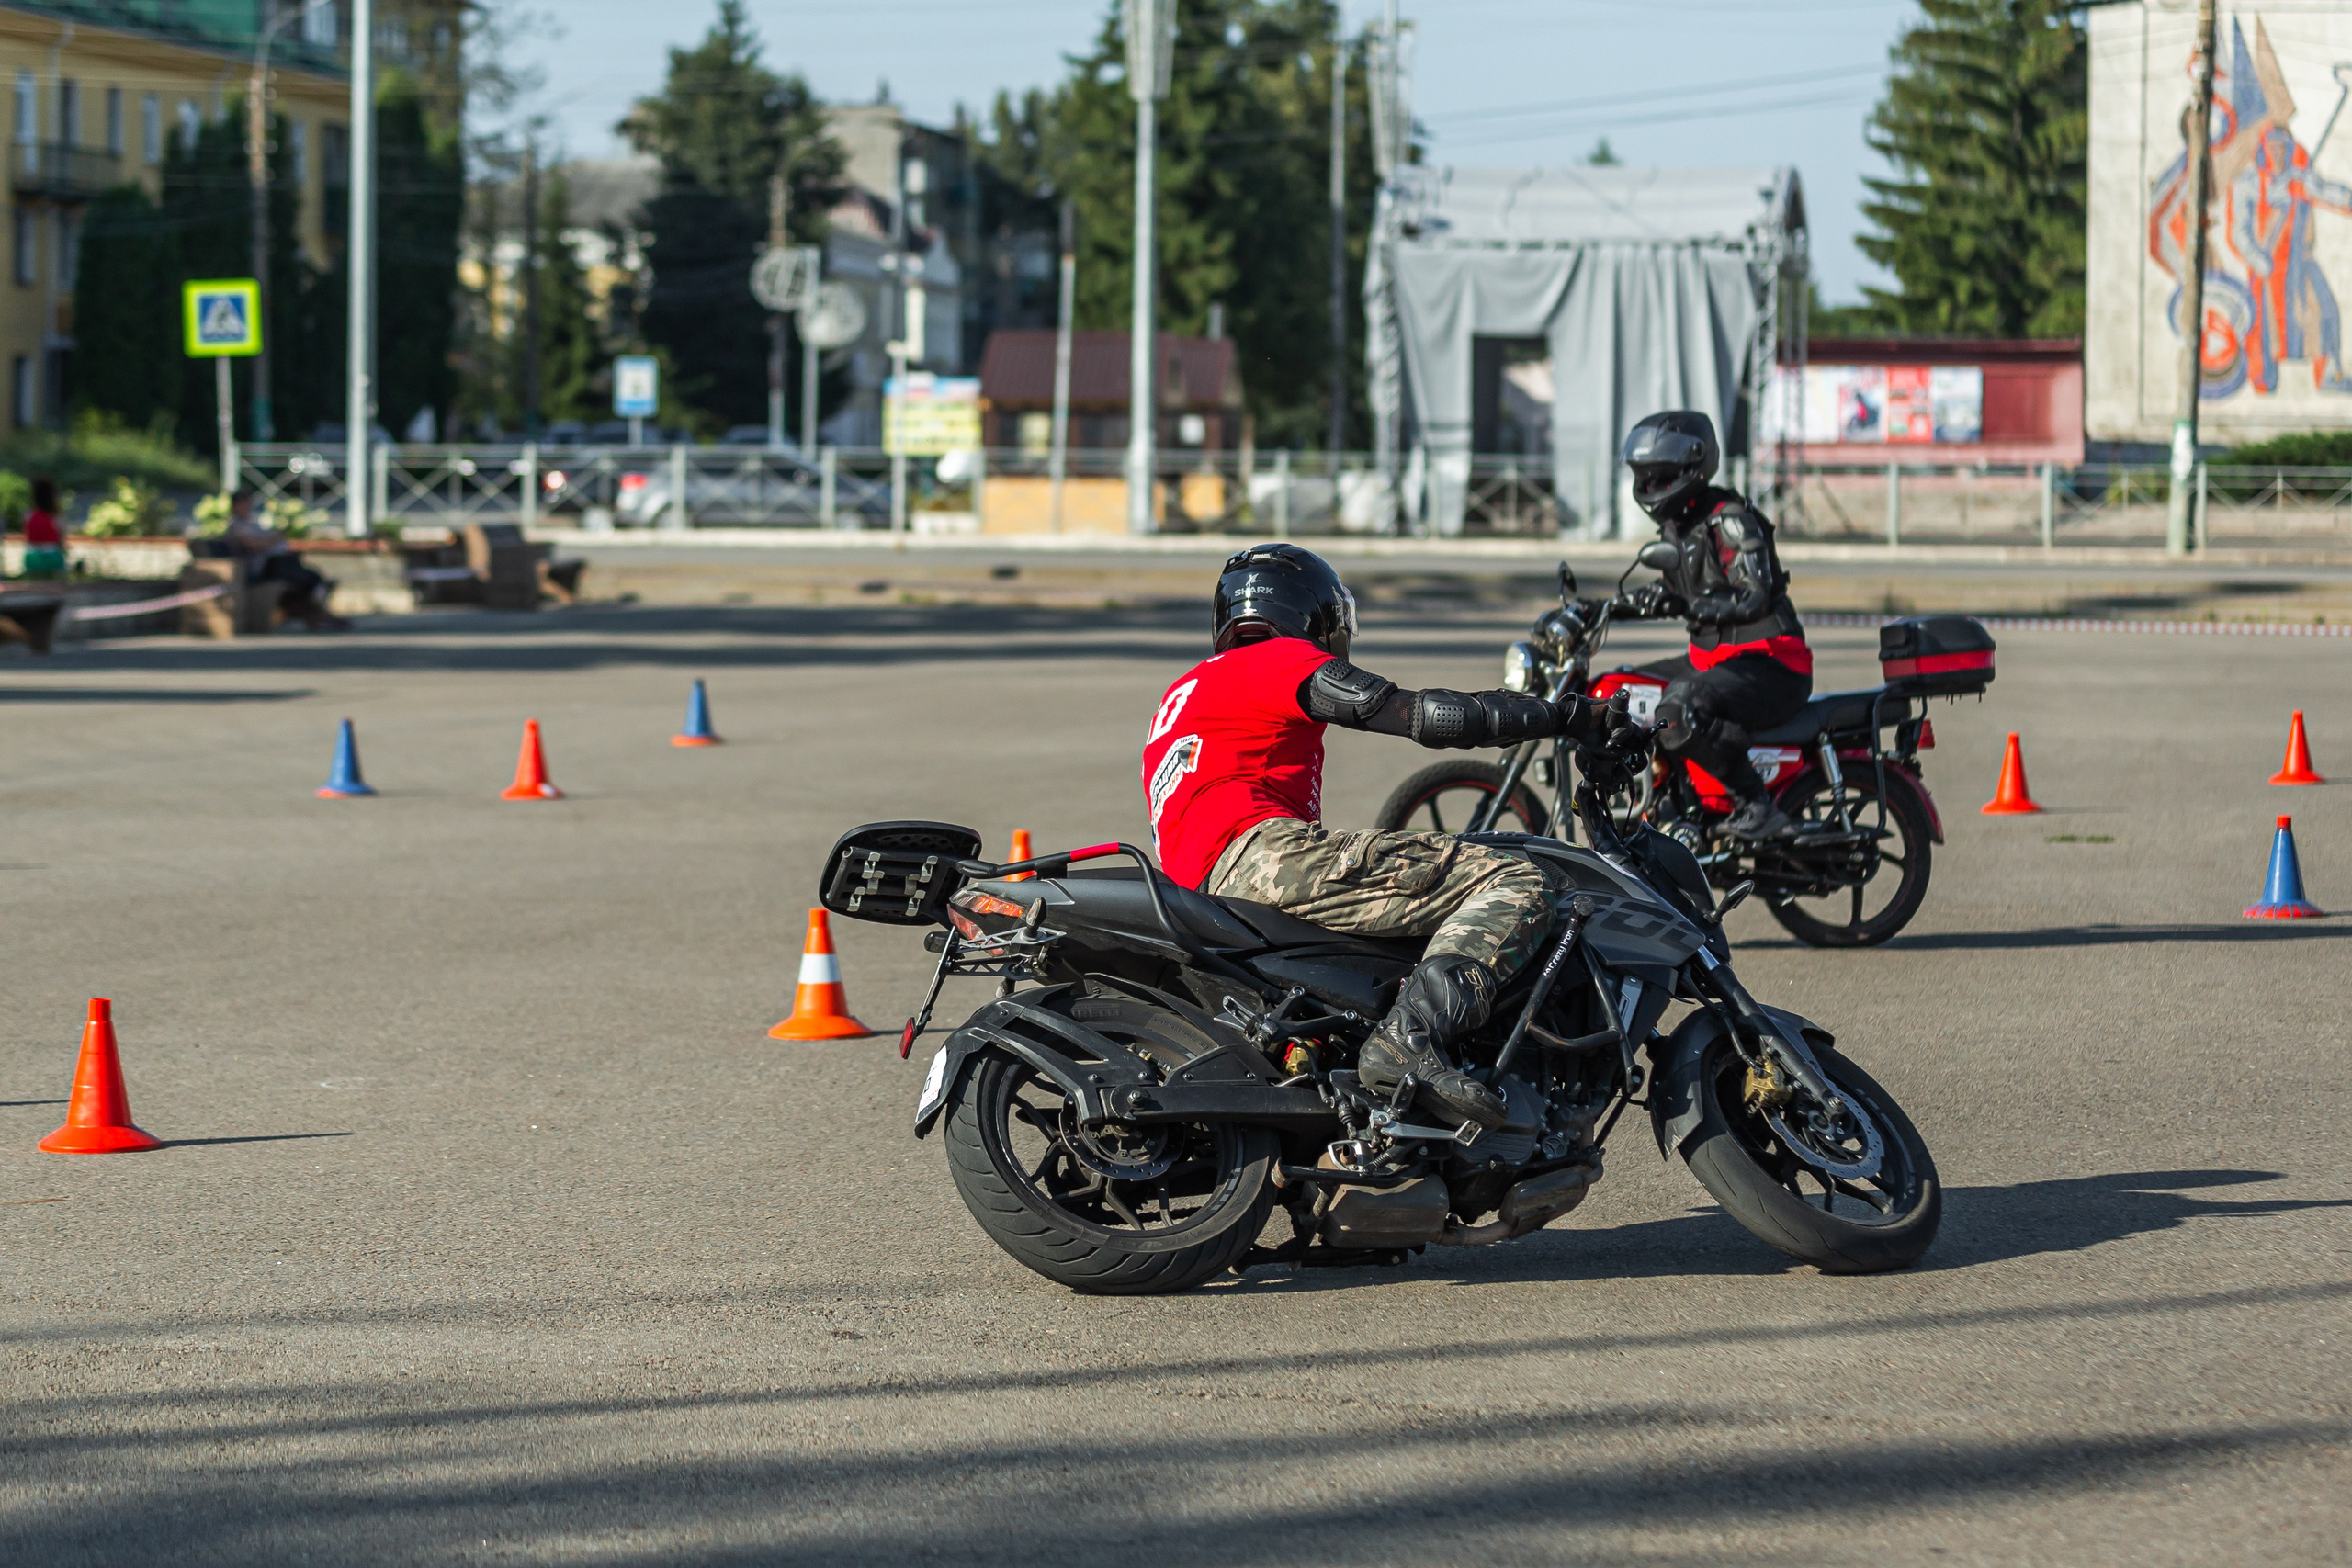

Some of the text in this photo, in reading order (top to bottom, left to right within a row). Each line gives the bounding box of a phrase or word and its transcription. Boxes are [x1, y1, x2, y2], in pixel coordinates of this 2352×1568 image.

[1234, 586, 1274, 597] SHARK
[1560, 929, 1575, 947] Iron
[1070, 1008, 1120, 1018] IRELLI
